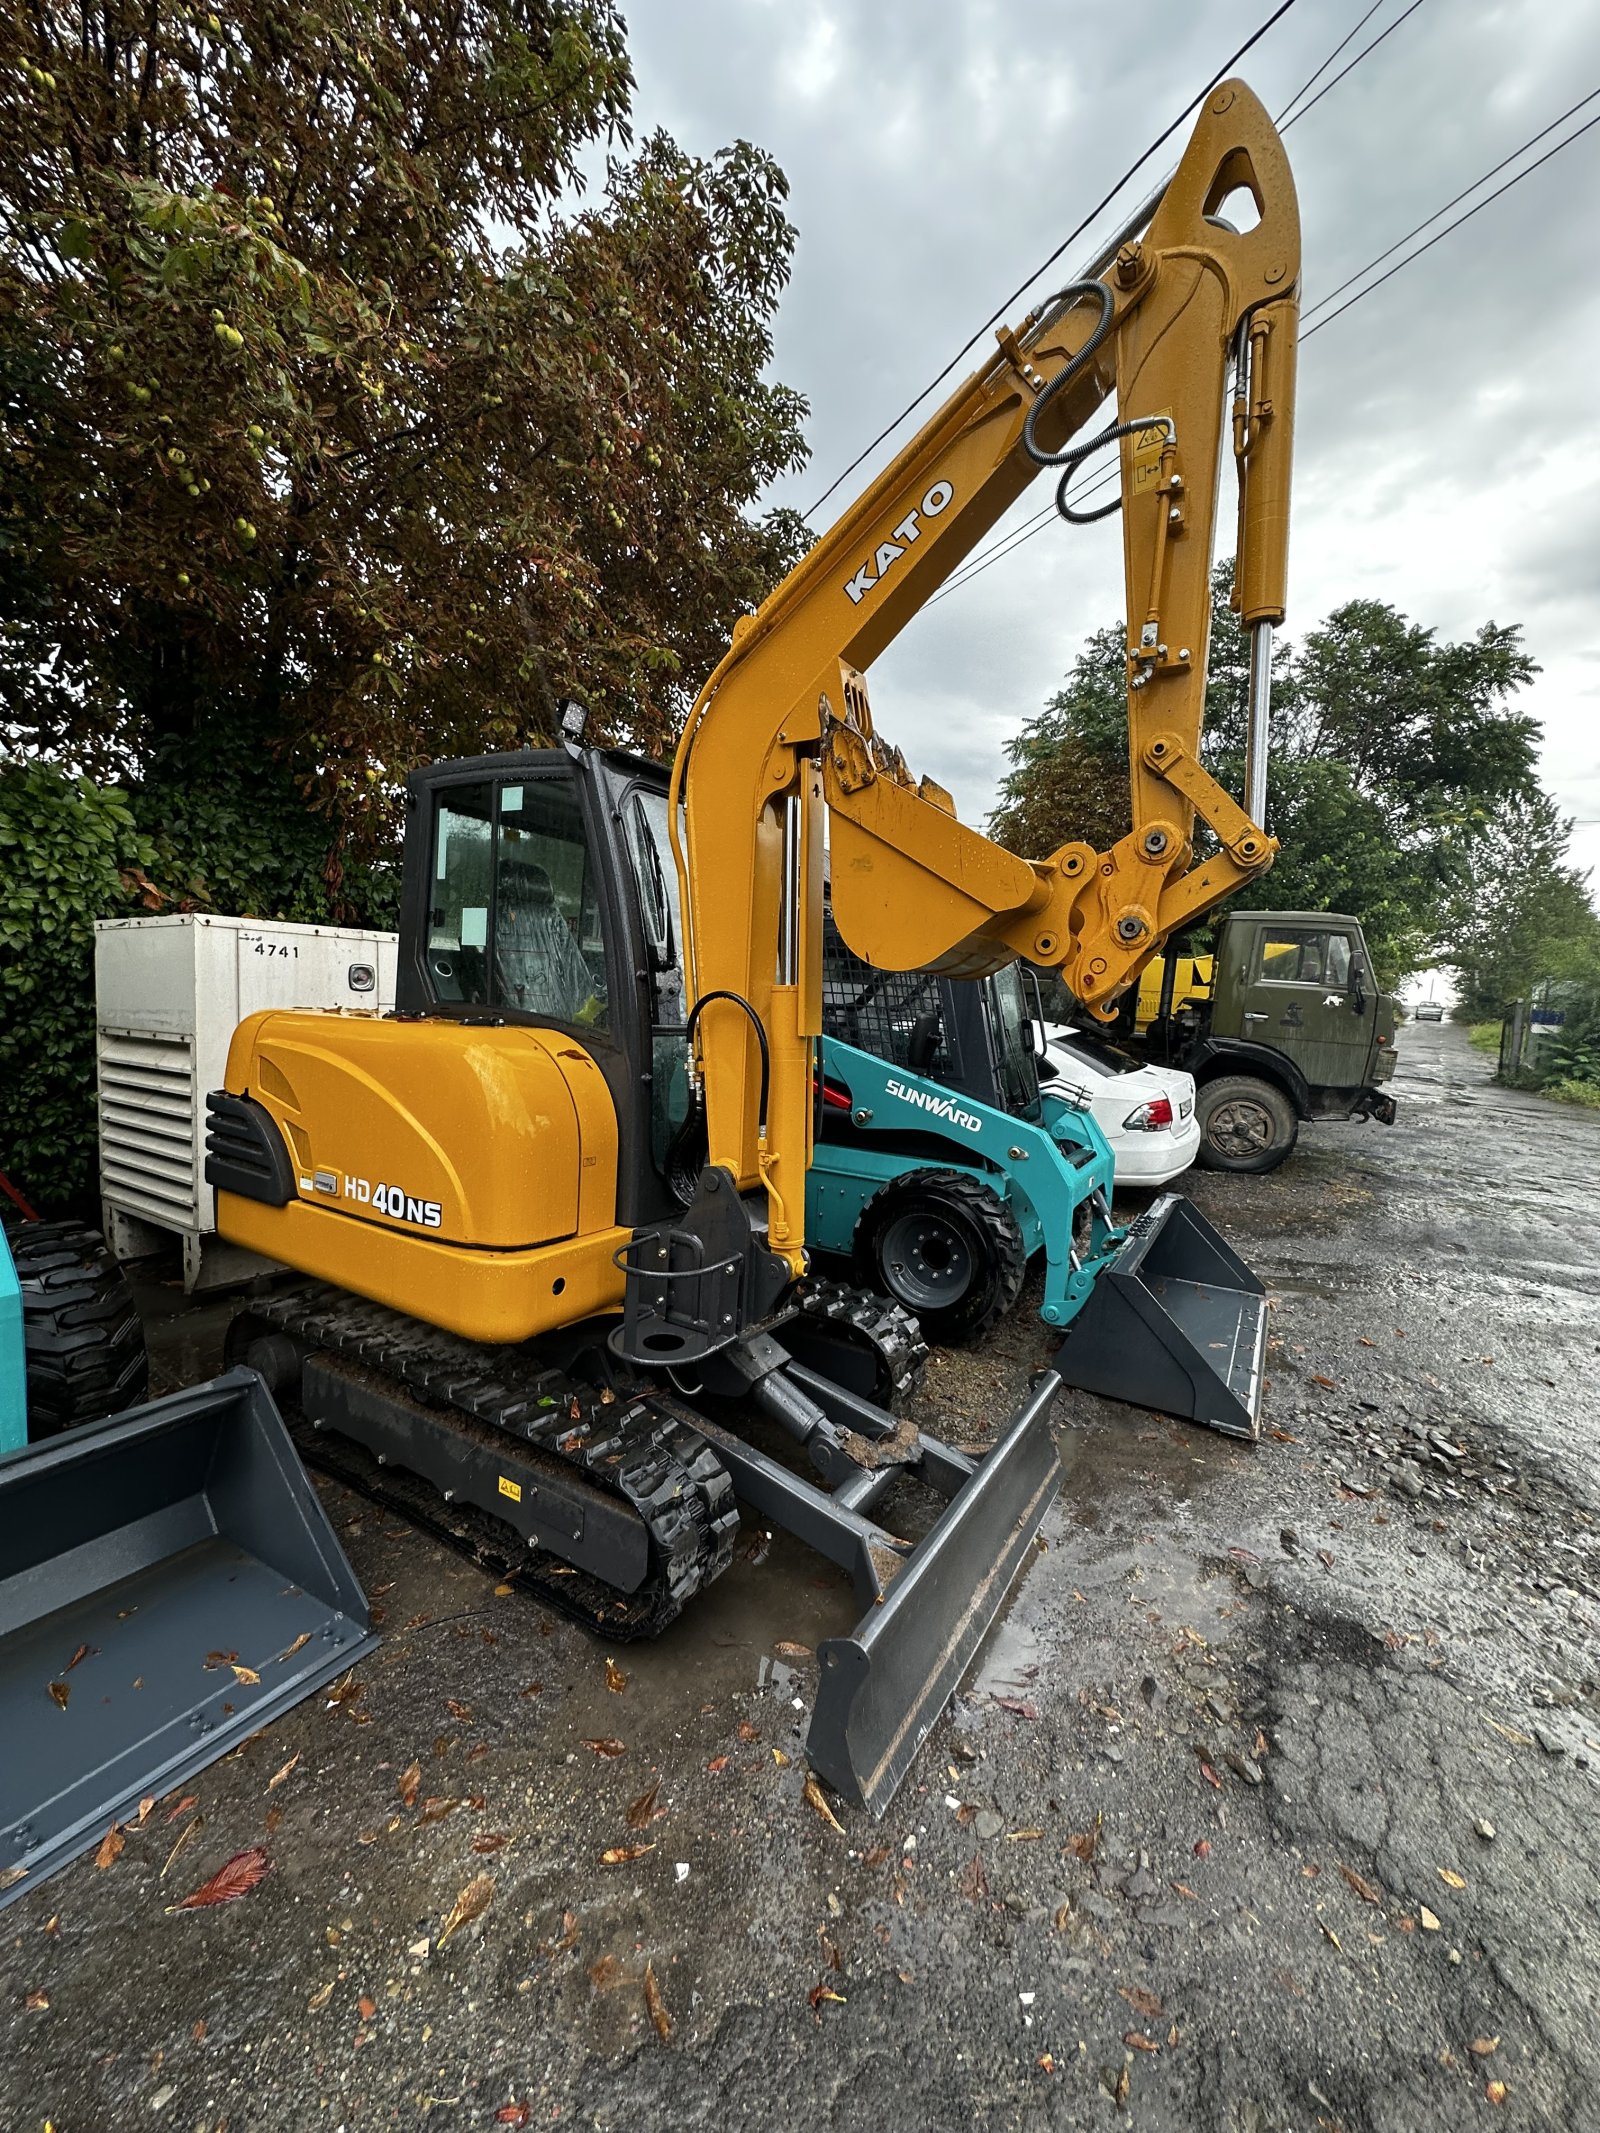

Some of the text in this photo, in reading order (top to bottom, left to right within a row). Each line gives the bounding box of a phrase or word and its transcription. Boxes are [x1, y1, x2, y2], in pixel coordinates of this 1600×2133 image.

[843, 480, 954, 605] KATO
[254, 943, 299, 959] 4741
[884, 1079, 983, 1133] SUNWARD
